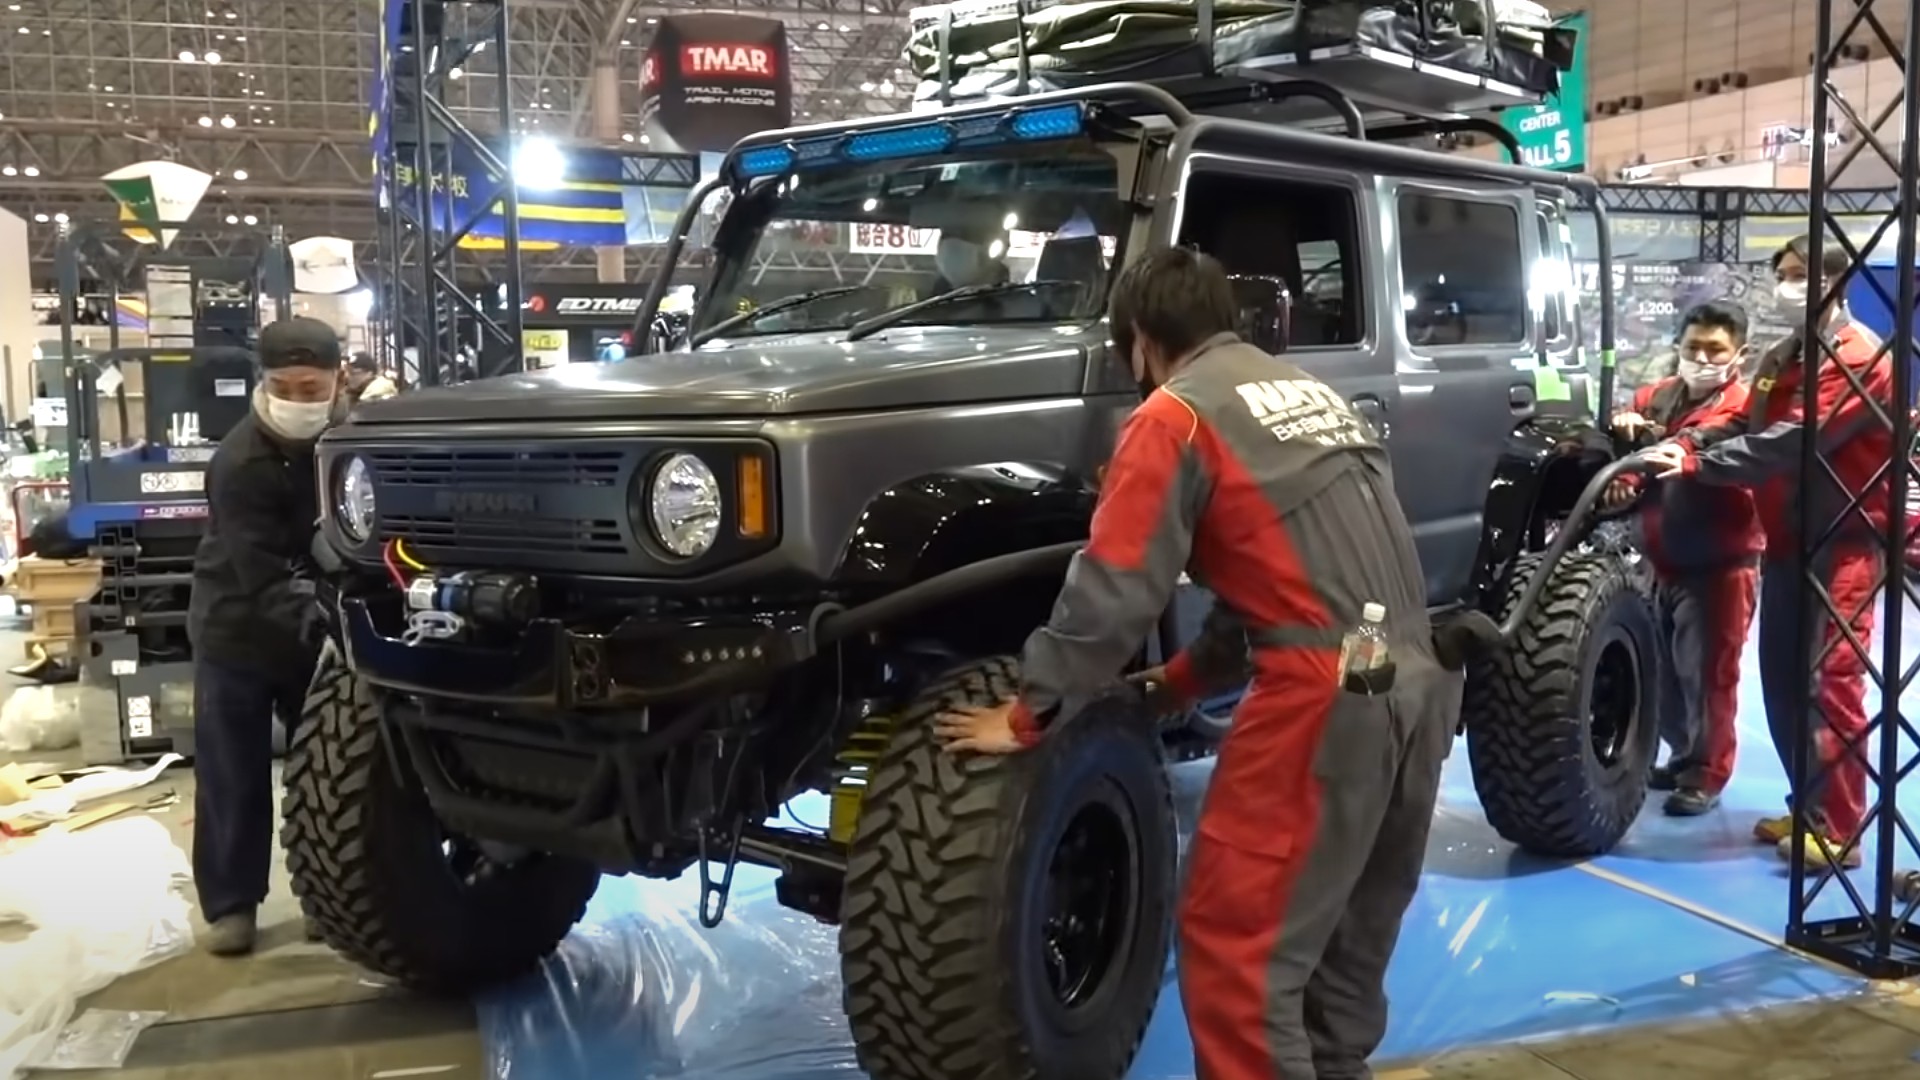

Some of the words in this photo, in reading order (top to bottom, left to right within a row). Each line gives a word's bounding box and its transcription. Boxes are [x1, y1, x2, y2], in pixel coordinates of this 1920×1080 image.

[688, 47, 768, 74] TMAR
[684, 86, 728, 95] TRAIL
[733, 87, 775, 97] MOTOR
[1520, 111, 1561, 132] CENTER
[1517, 144, 1554, 166] ALL
[1554, 128, 1571, 163] 5
